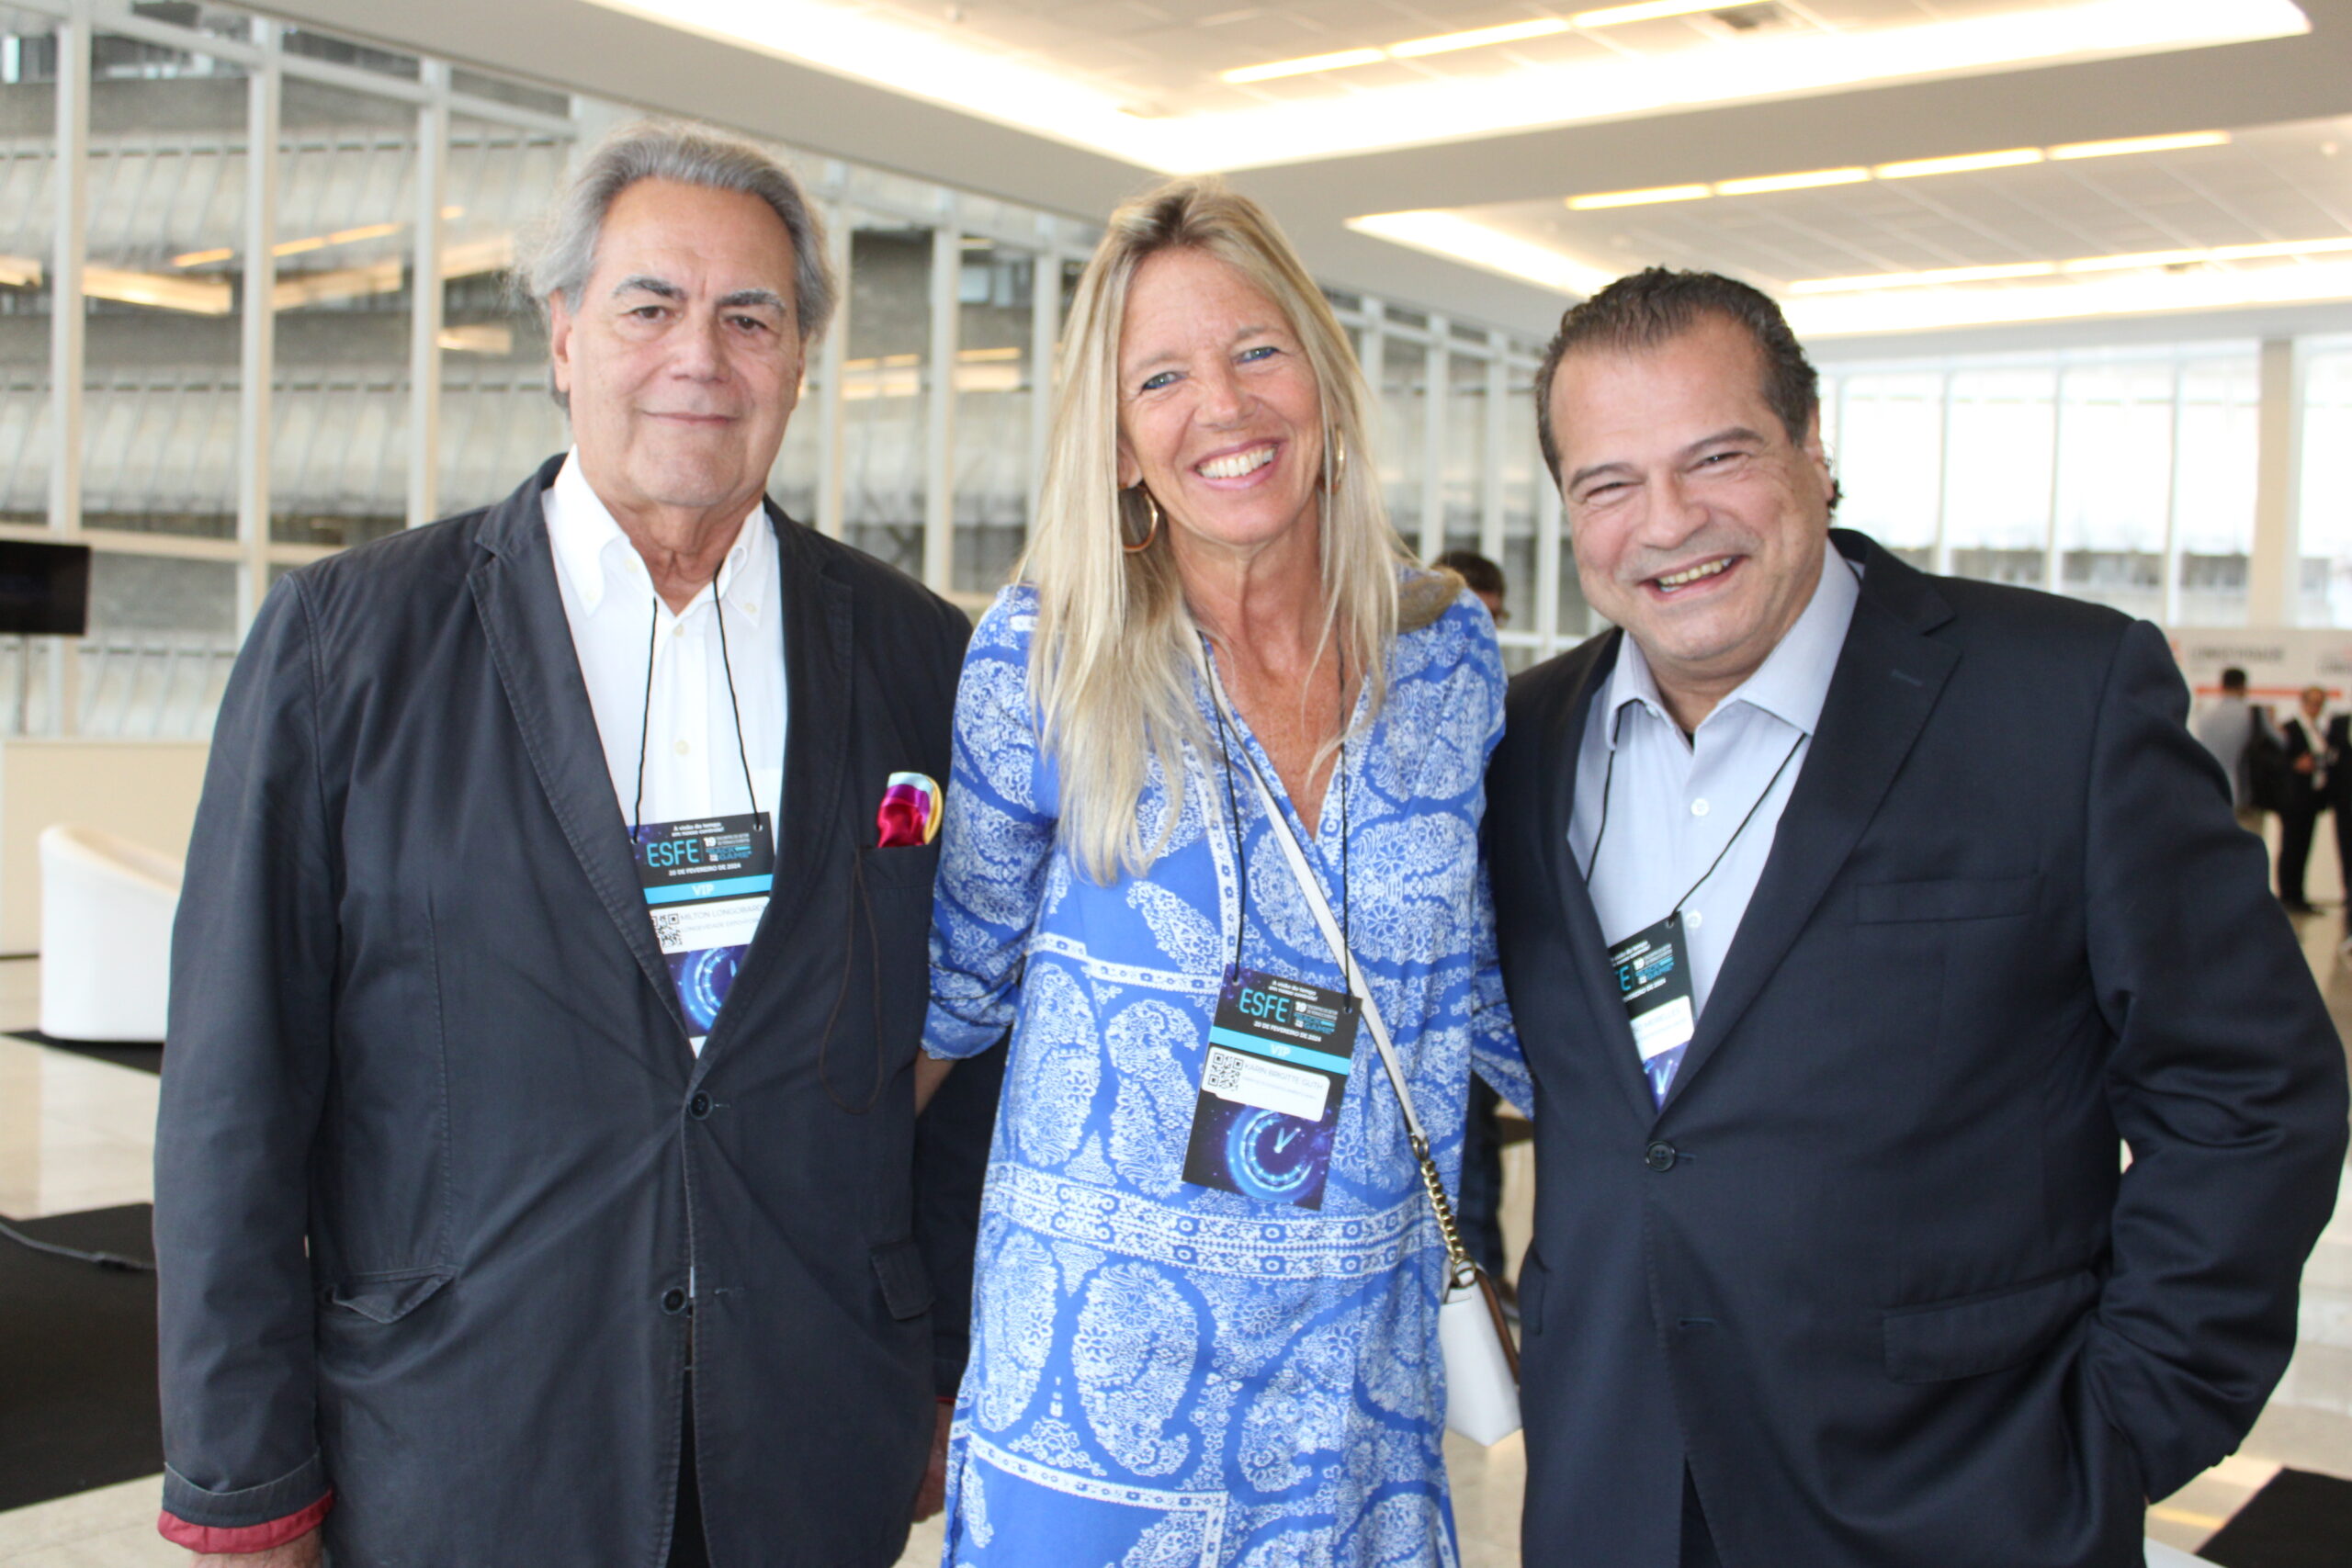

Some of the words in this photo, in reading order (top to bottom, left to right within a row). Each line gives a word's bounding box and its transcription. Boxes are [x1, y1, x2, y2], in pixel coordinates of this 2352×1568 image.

[703, 836, 717, 847] 19
[646, 838, 700, 867] ESFE
[685, 865, 718, 874] FEVEREIRO
[727, 863, 742, 871] 2024
[691, 884, 715, 896] VIP
[1238, 987, 1290, 1022] ESFE
[1295, 1001, 1307, 1012] 19
[1270, 1024, 1300, 1037] FEVEREIRO
[1300, 1031, 1308, 1039] DE
[1308, 1033, 1322, 1043] 2024
[1270, 1043, 1291, 1057] VIP
